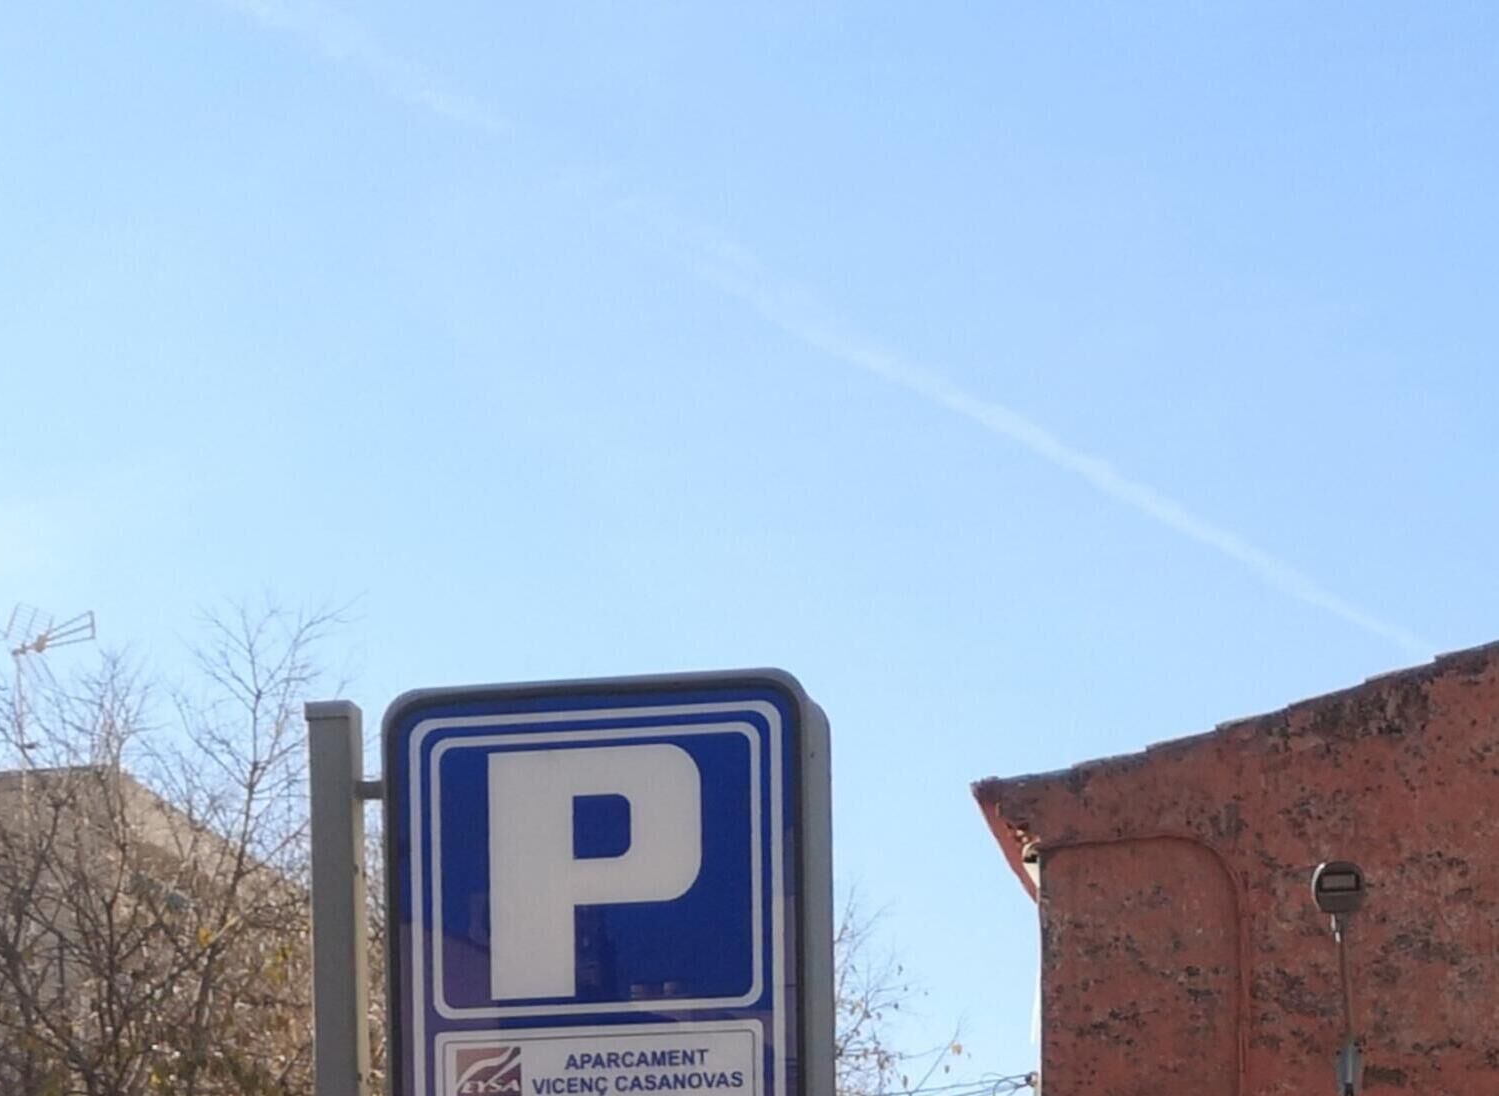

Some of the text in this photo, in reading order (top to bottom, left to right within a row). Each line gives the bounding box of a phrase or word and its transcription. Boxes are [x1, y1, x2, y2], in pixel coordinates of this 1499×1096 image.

[488, 743, 703, 1001] P
[565, 1048, 709, 1071] APARCAMENT
[532, 1071, 744, 1096] VICENÇ CASANOVAS
